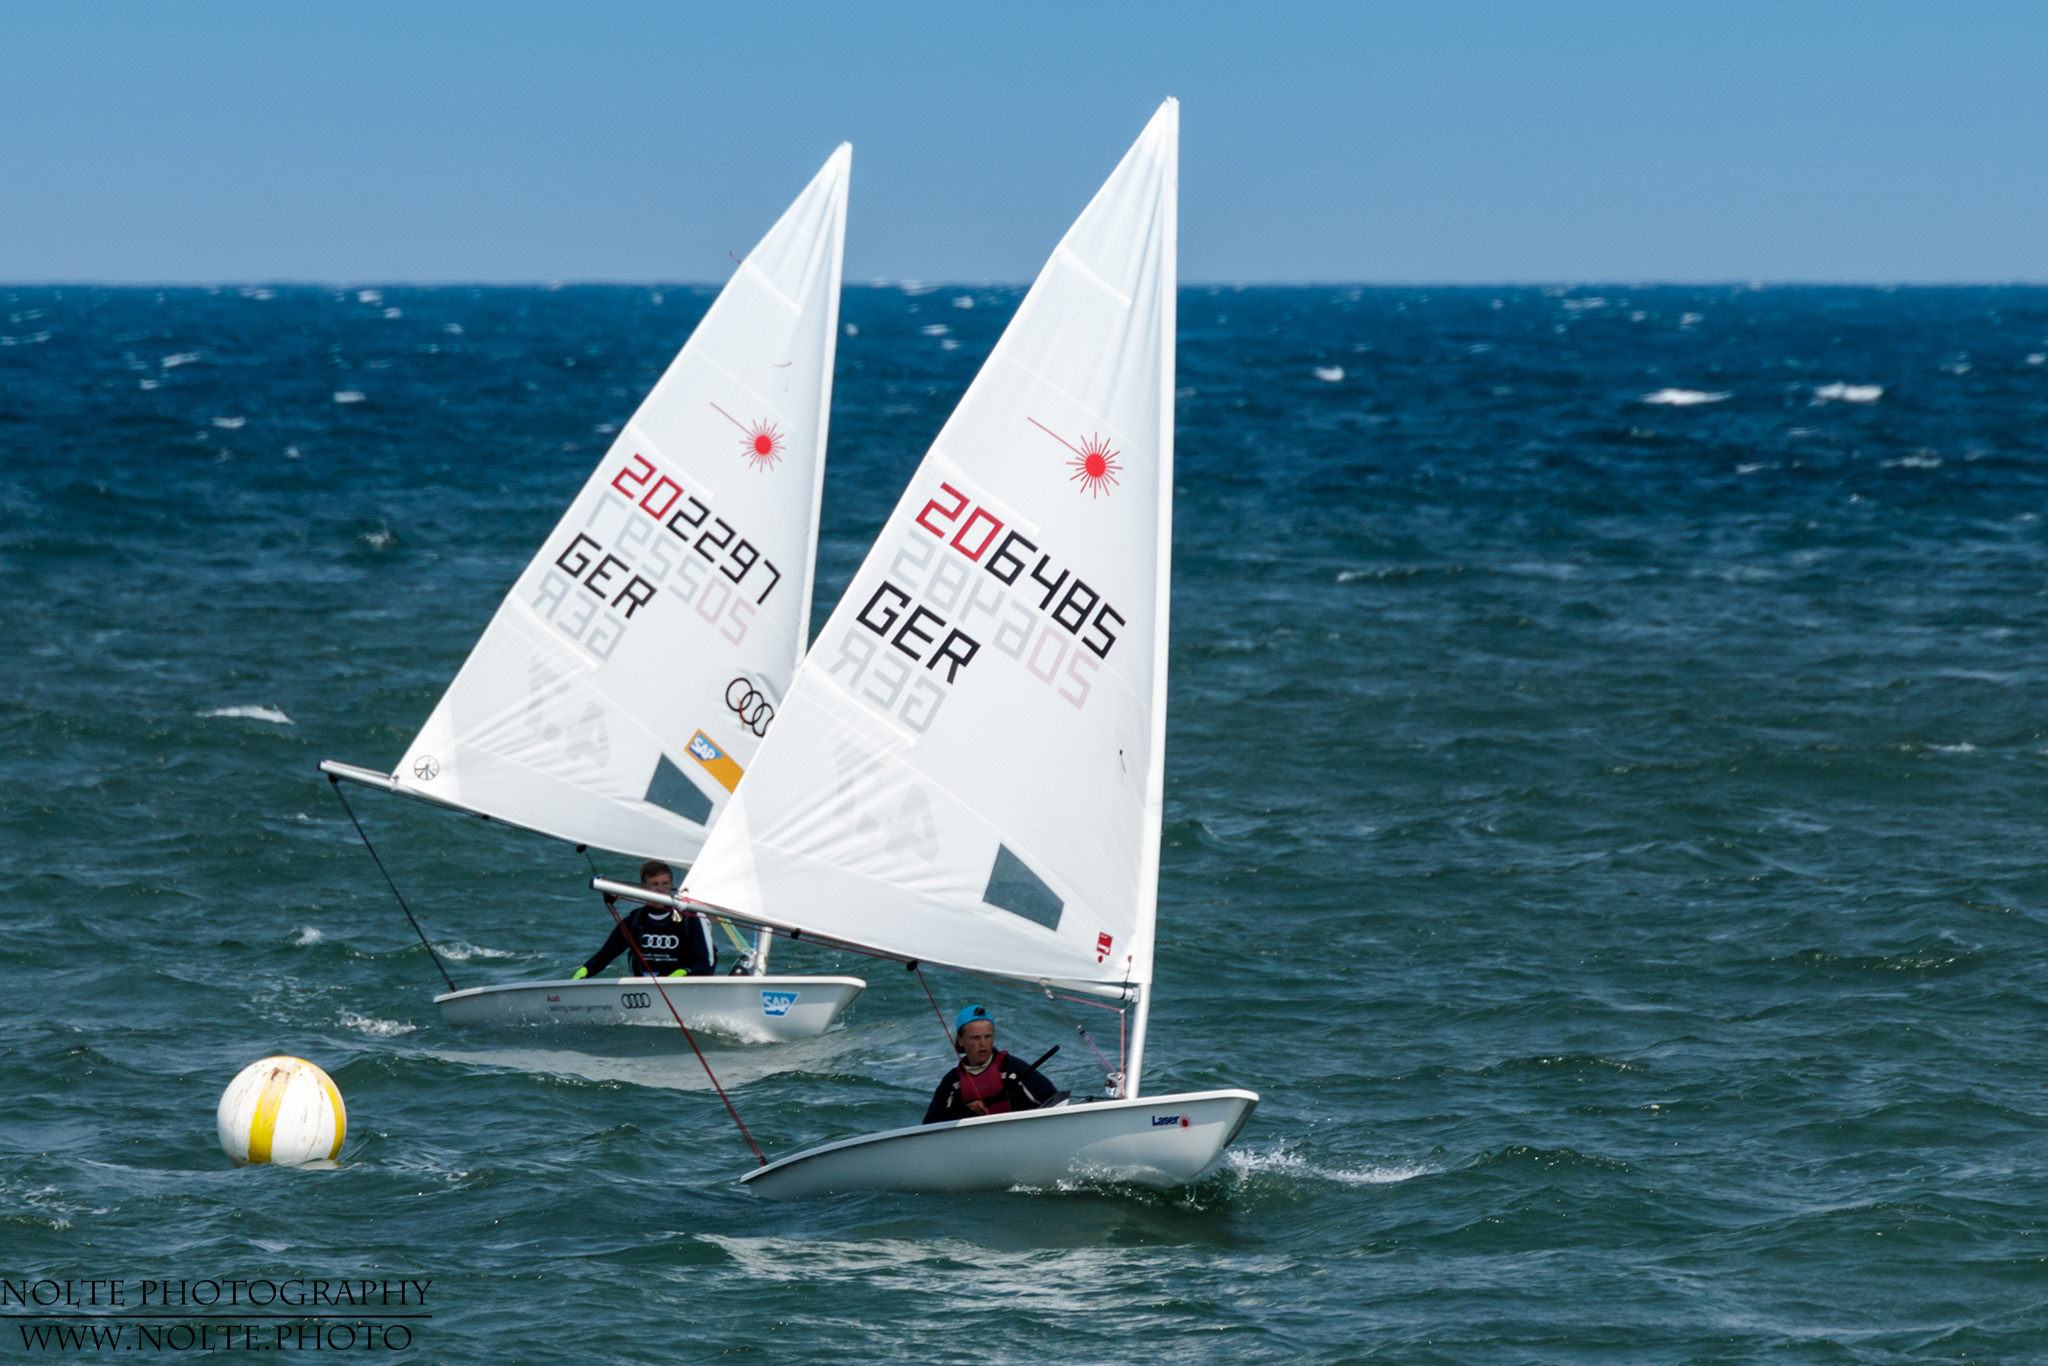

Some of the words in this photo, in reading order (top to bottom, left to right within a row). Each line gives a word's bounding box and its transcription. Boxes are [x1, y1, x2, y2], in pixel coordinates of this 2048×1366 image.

[611, 453, 781, 605] 202297
[915, 481, 1126, 660] 206485
[555, 532, 657, 619] GER
[856, 580, 981, 685] GER
[690, 737, 716, 760] SAP
[763, 995, 790, 1012] SAP
[1152, 1115, 1180, 1126] Laser
